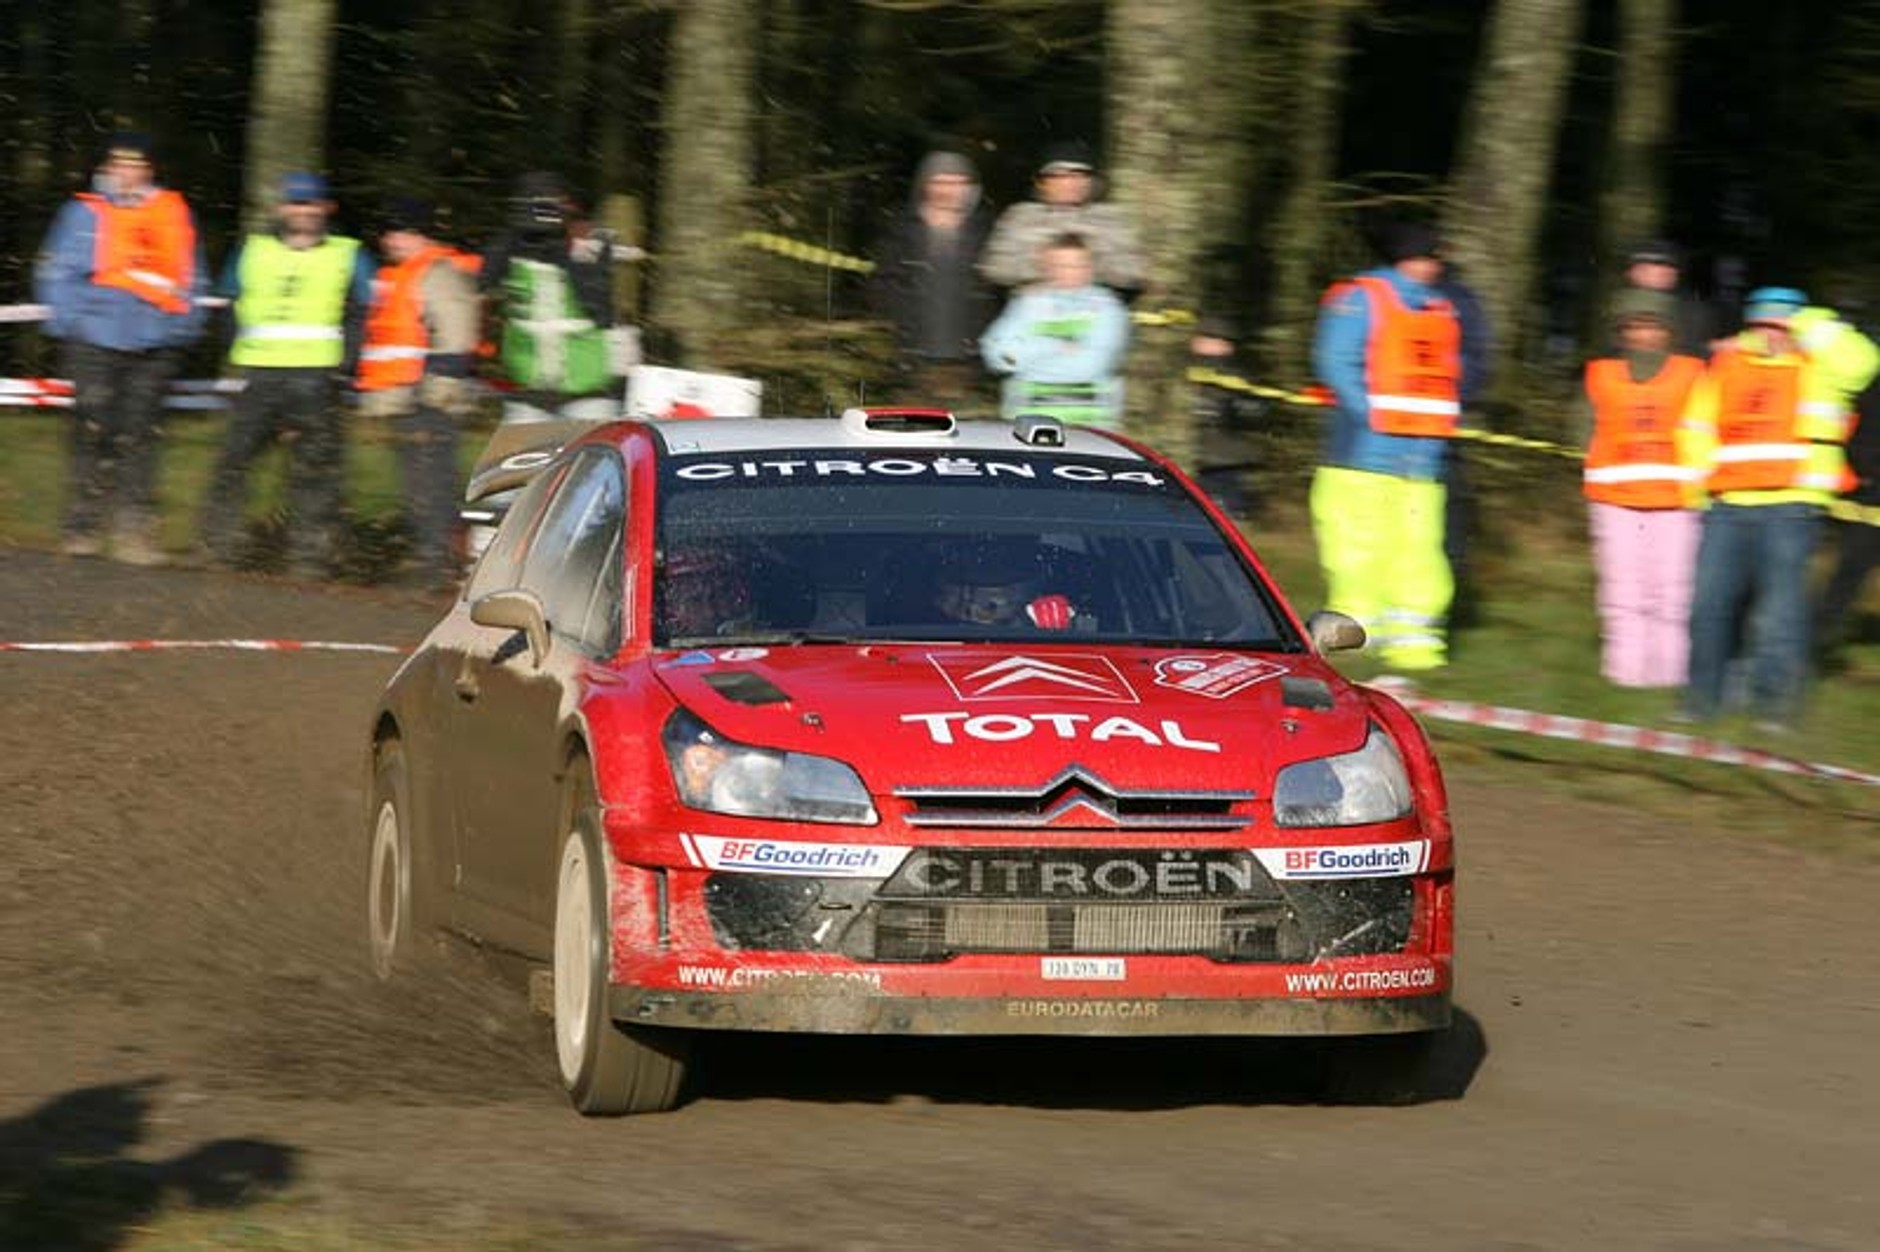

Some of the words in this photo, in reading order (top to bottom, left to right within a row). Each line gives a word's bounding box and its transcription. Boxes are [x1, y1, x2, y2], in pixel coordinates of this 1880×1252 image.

[676, 458, 1036, 480] CITROËN
[1052, 465, 1165, 485] C4
[900, 711, 1221, 752] TOTAL
[720, 841, 880, 867] BFGoodrich
[1285, 847, 1410, 869] BFGoodrich
[904, 850, 1251, 894] CITROËN
[1007, 1002, 1160, 1017] EURODATACAR
